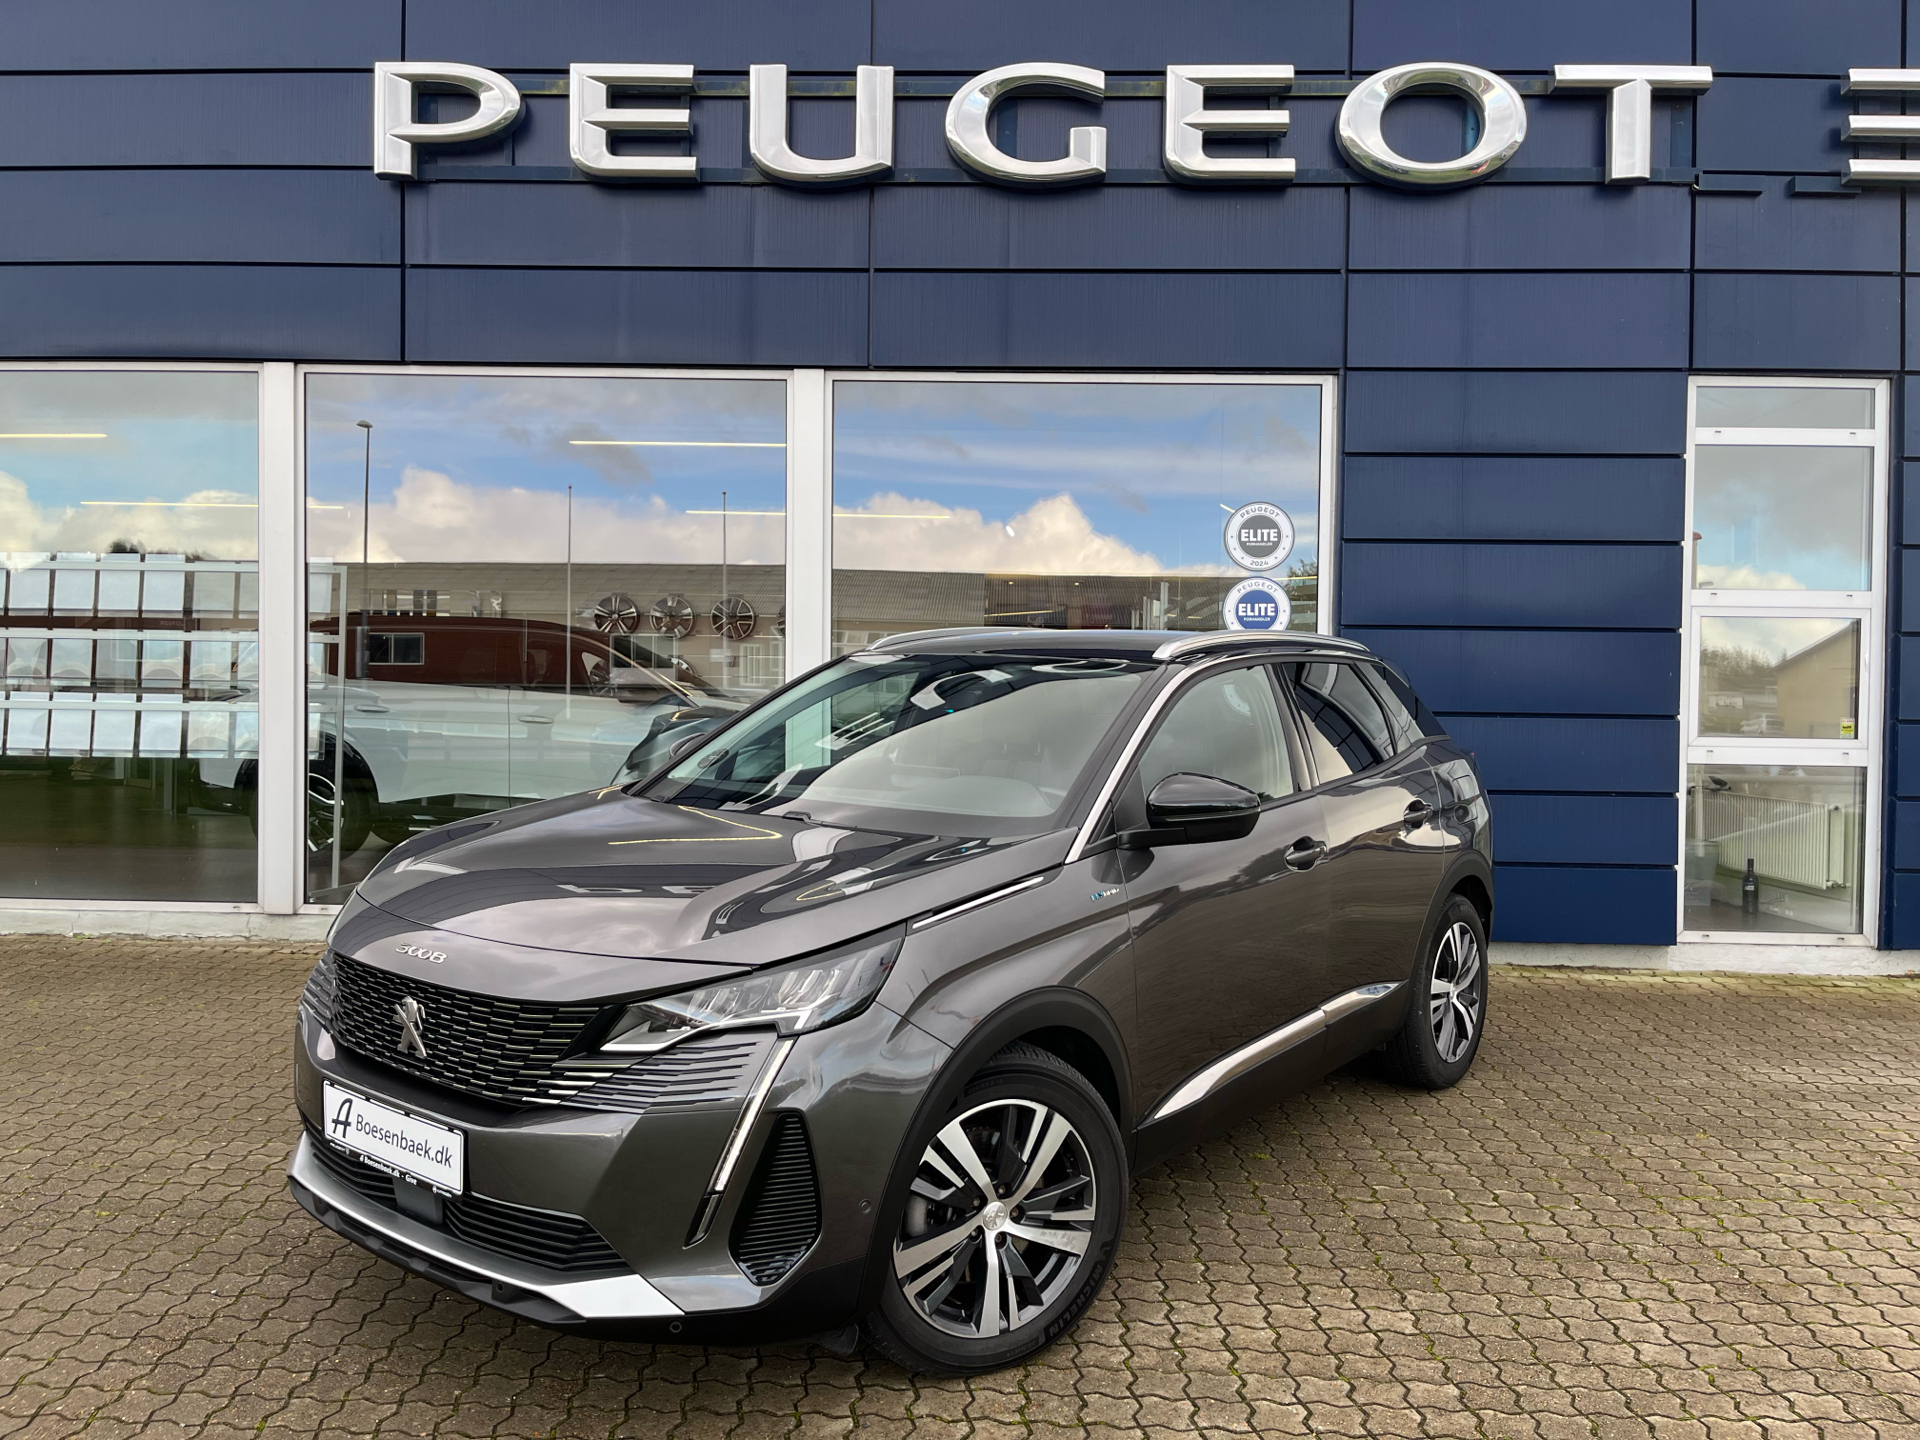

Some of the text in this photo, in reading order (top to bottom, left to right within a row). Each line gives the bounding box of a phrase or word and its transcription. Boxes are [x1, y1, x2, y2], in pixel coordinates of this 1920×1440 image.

[373, 61, 1713, 186] PEUGEOT
[1240, 506, 1280, 519] PEUGEOT
[1240, 528, 1278, 542] ELITE
[1250, 559, 1269, 567] 2024
[1237, 581, 1278, 594] PEUGEOT
[1238, 603, 1275, 617] ELITE
[395, 942, 448, 964] 3008
[355, 1113, 453, 1169] Boesenbaek.dk
[1049, 1263, 1103, 1337] MICHELIN
